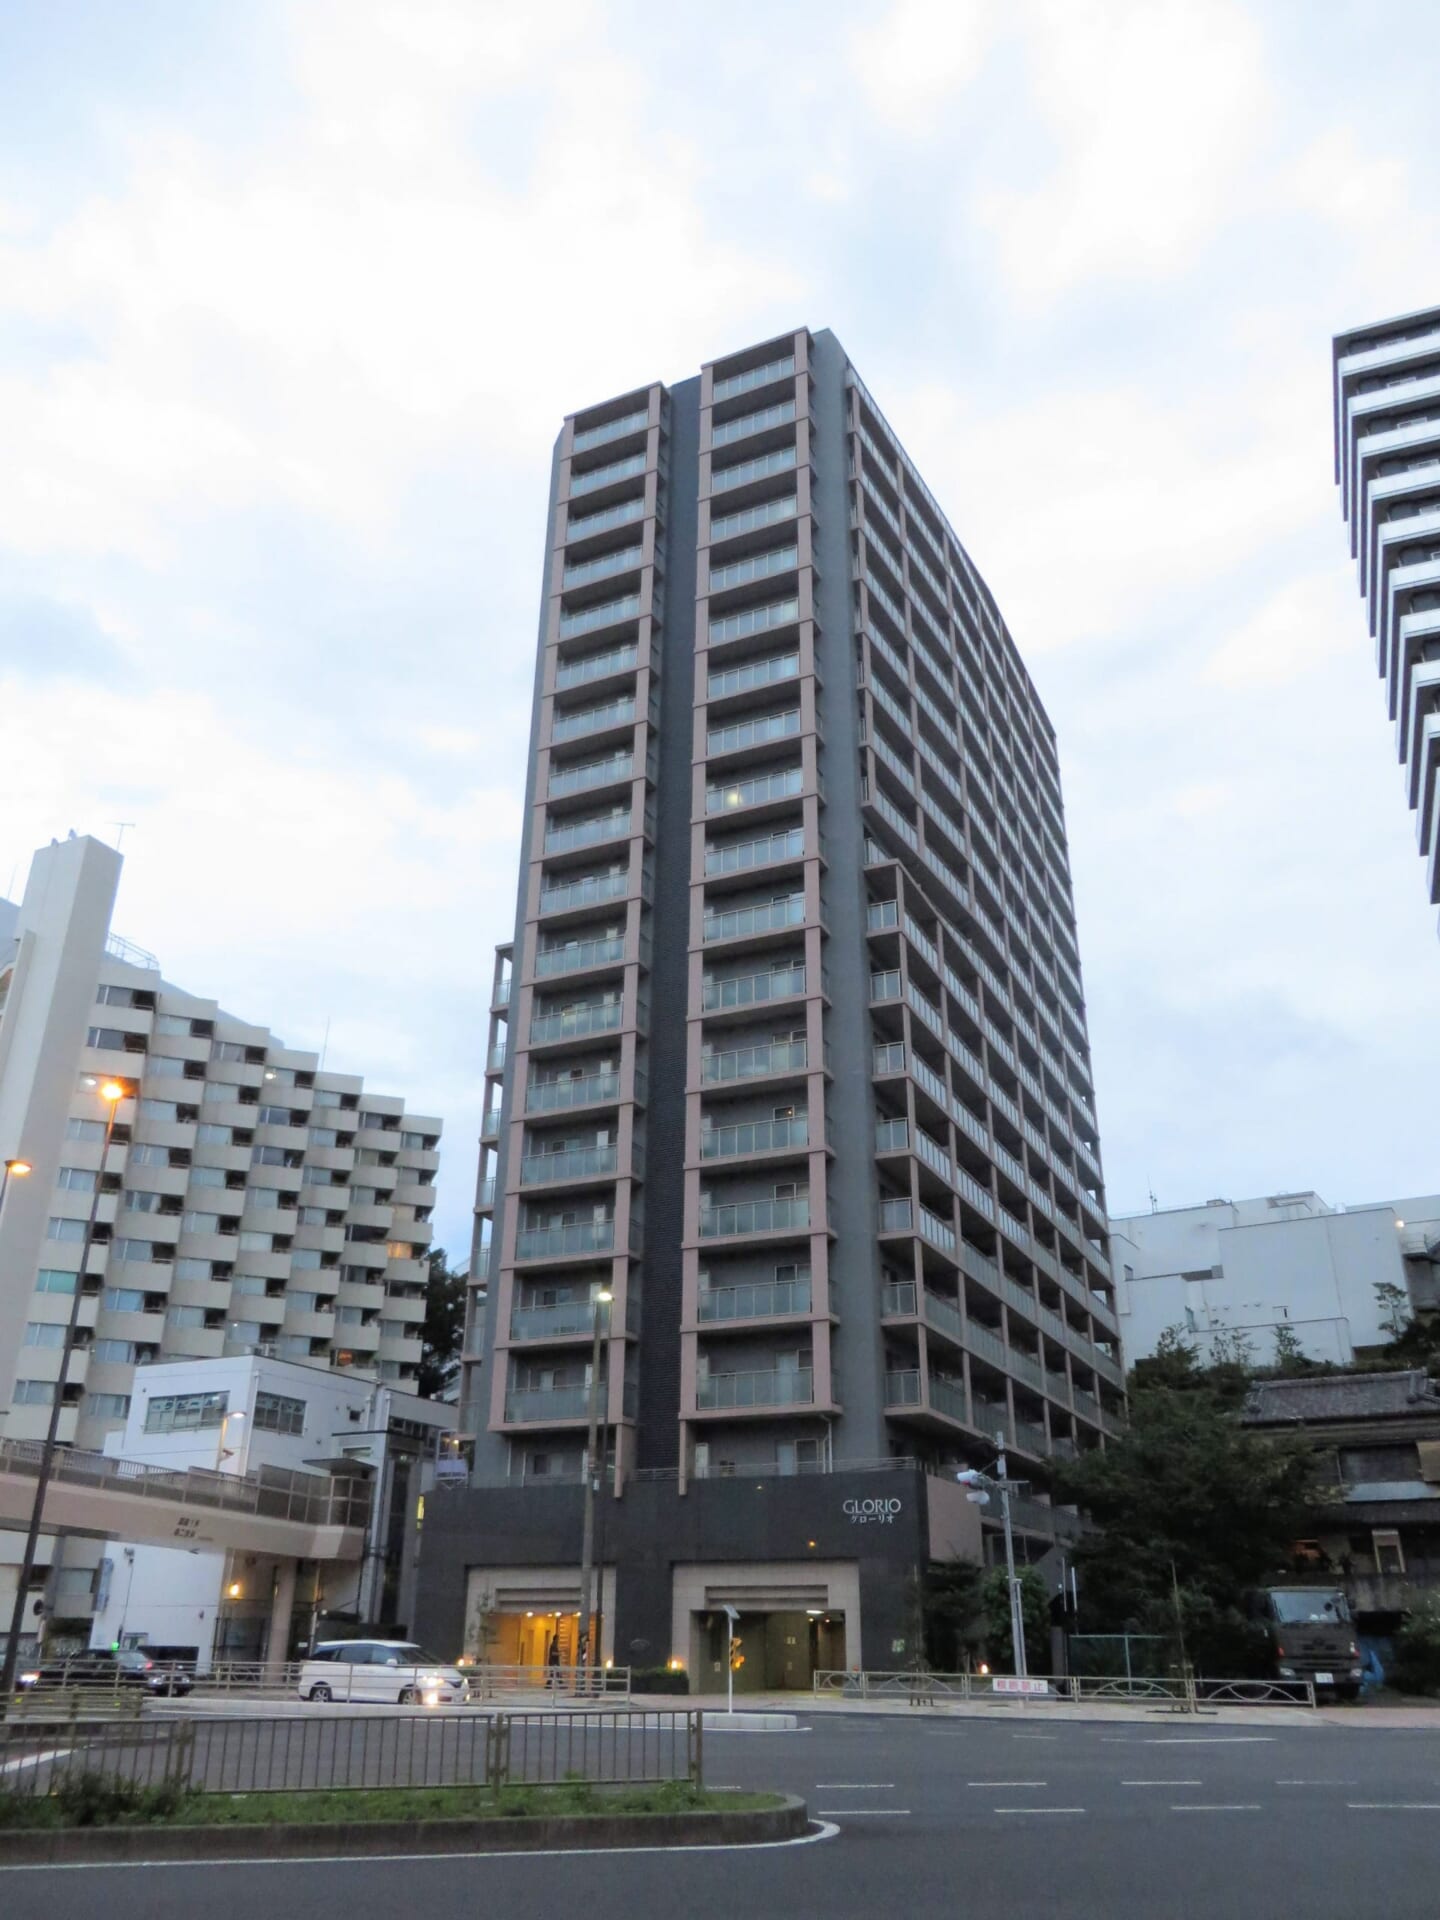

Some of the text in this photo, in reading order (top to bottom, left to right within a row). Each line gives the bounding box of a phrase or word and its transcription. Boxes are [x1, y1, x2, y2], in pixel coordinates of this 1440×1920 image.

[842, 1498, 902, 1514] GLORIO
[851, 1513, 895, 1524] グローリオ
